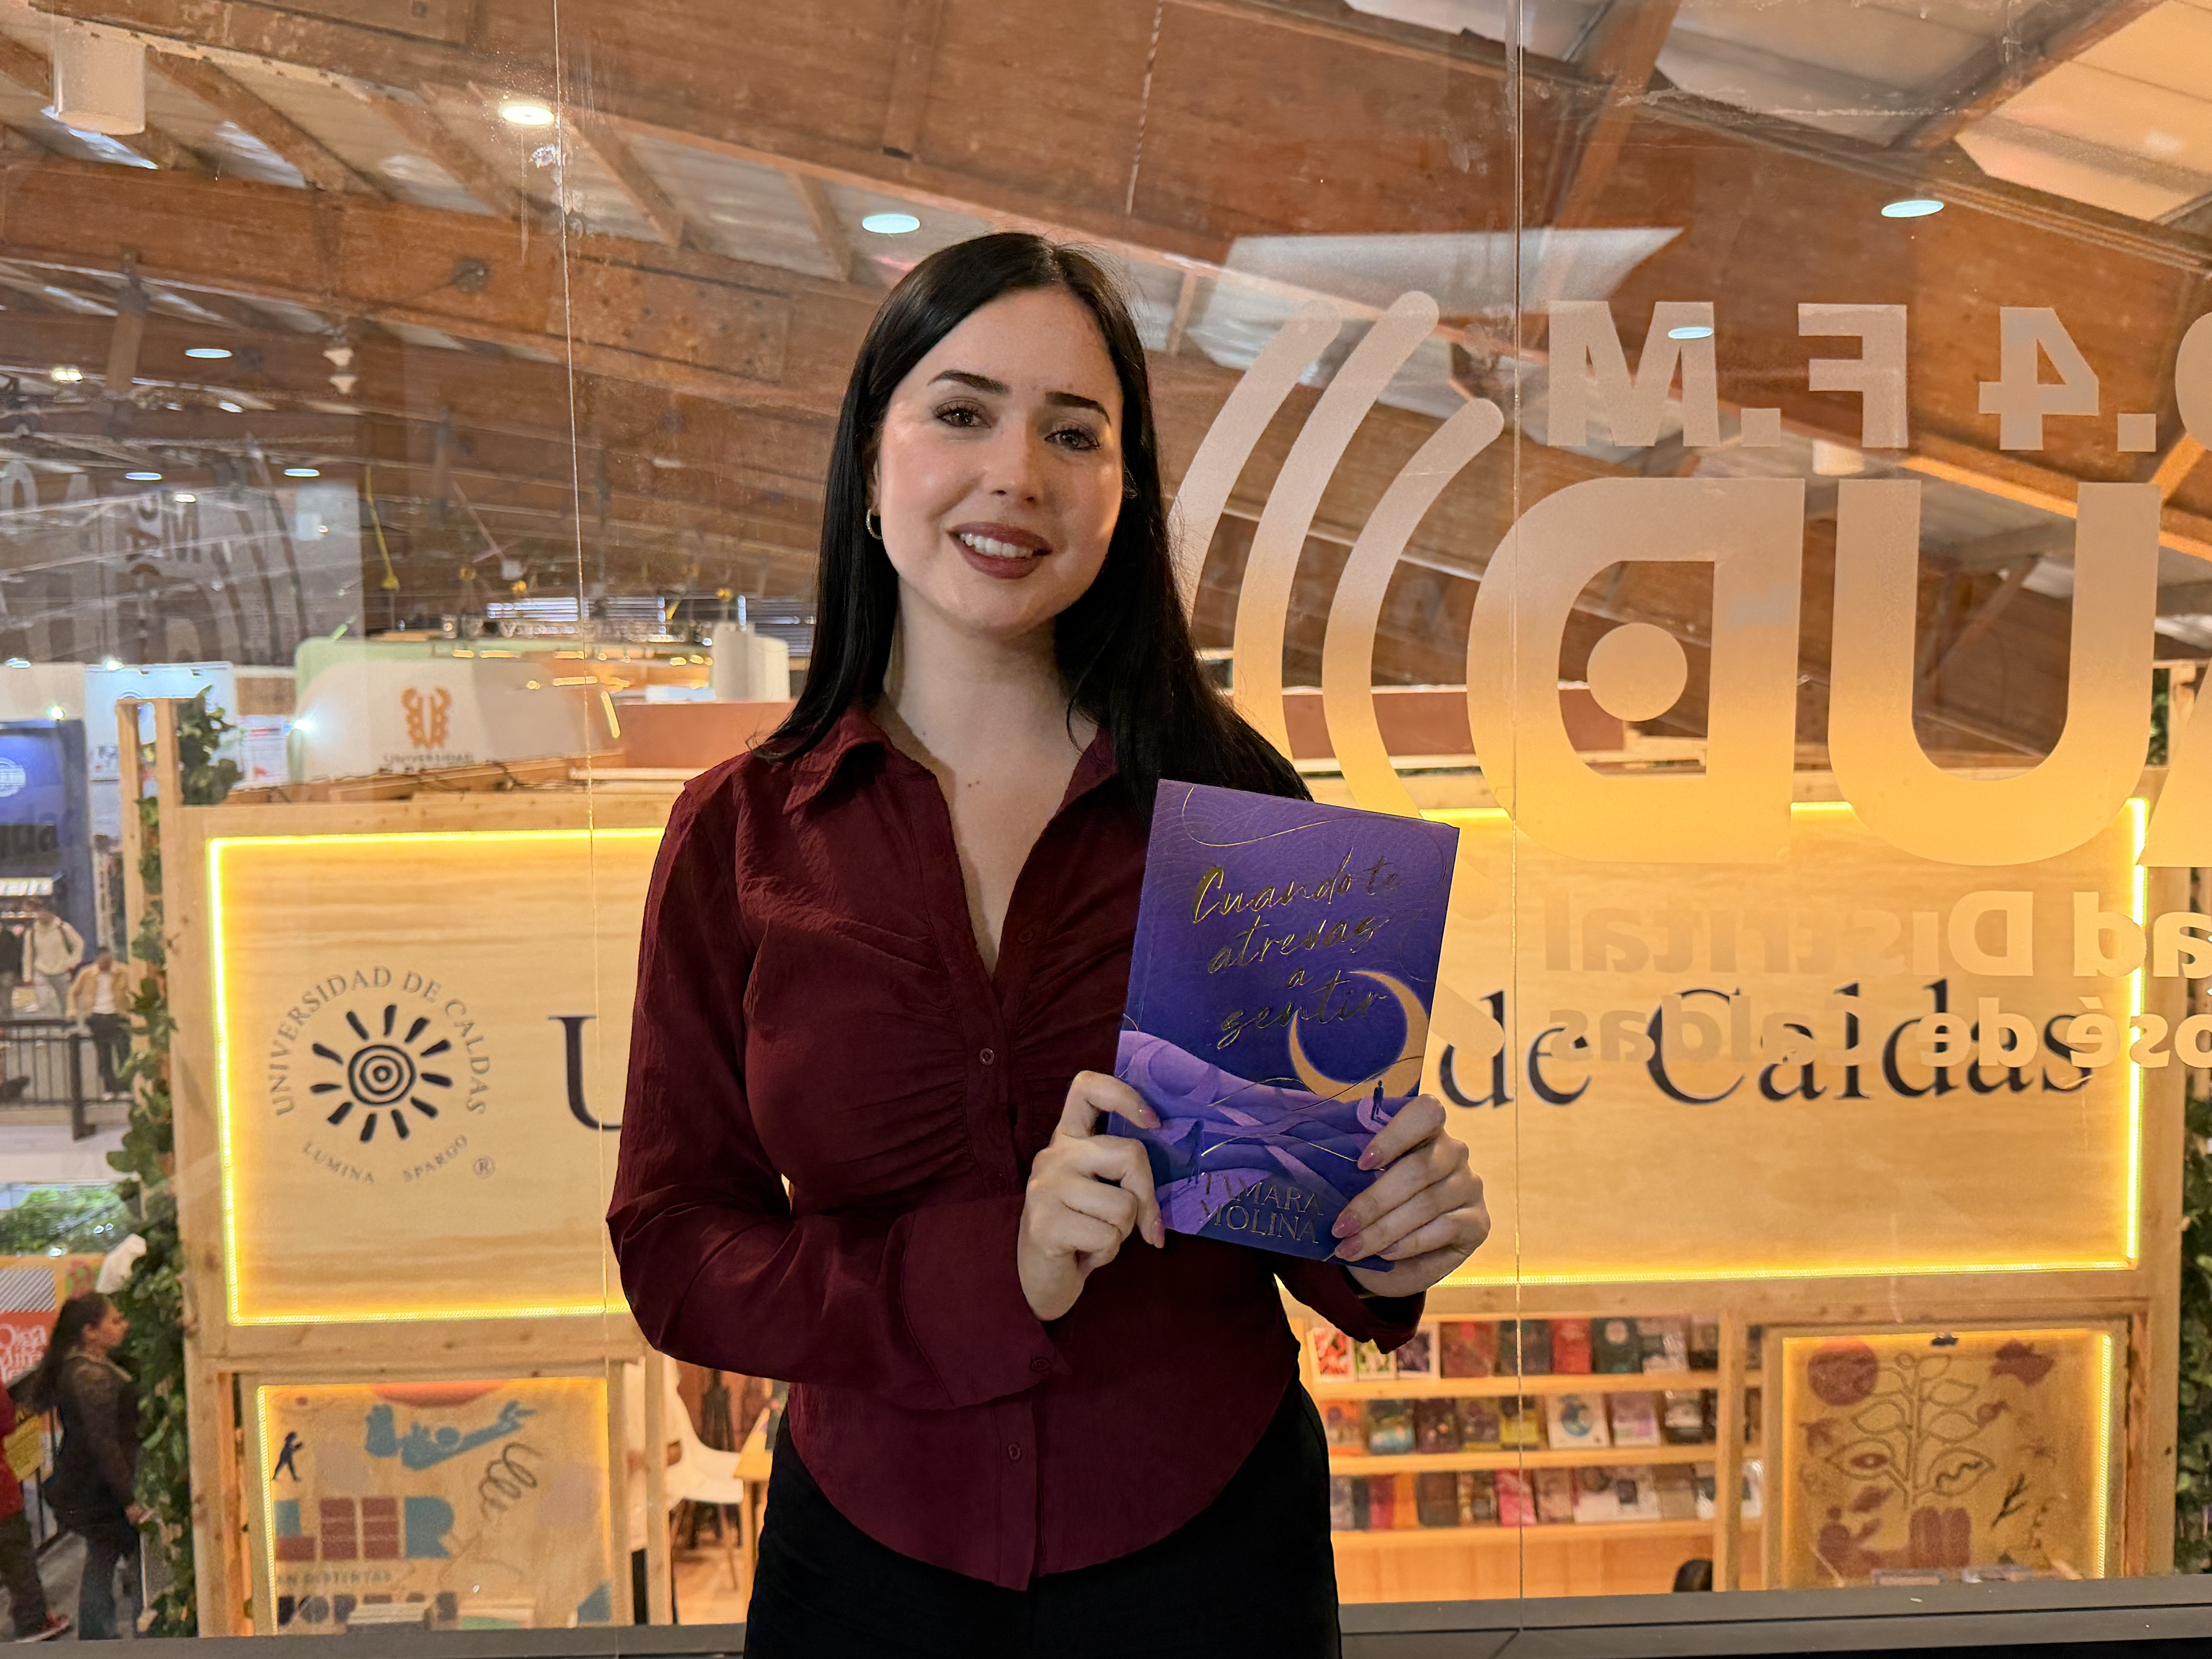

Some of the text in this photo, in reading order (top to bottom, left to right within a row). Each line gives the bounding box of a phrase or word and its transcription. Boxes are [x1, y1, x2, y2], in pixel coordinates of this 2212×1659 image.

[1194, 846, 1408, 924] Cuando te
[1207, 915, 1389, 974] atrevas
[1287, 967, 1313, 989] a
[268, 965, 491, 1116] UNIVERSIDAD DE CALDAS
[1439, 988, 1592, 1109] de
[1646, 978, 2094, 1104] Caldas
[302, 1135, 468, 1185] LUMINA SPARGO
